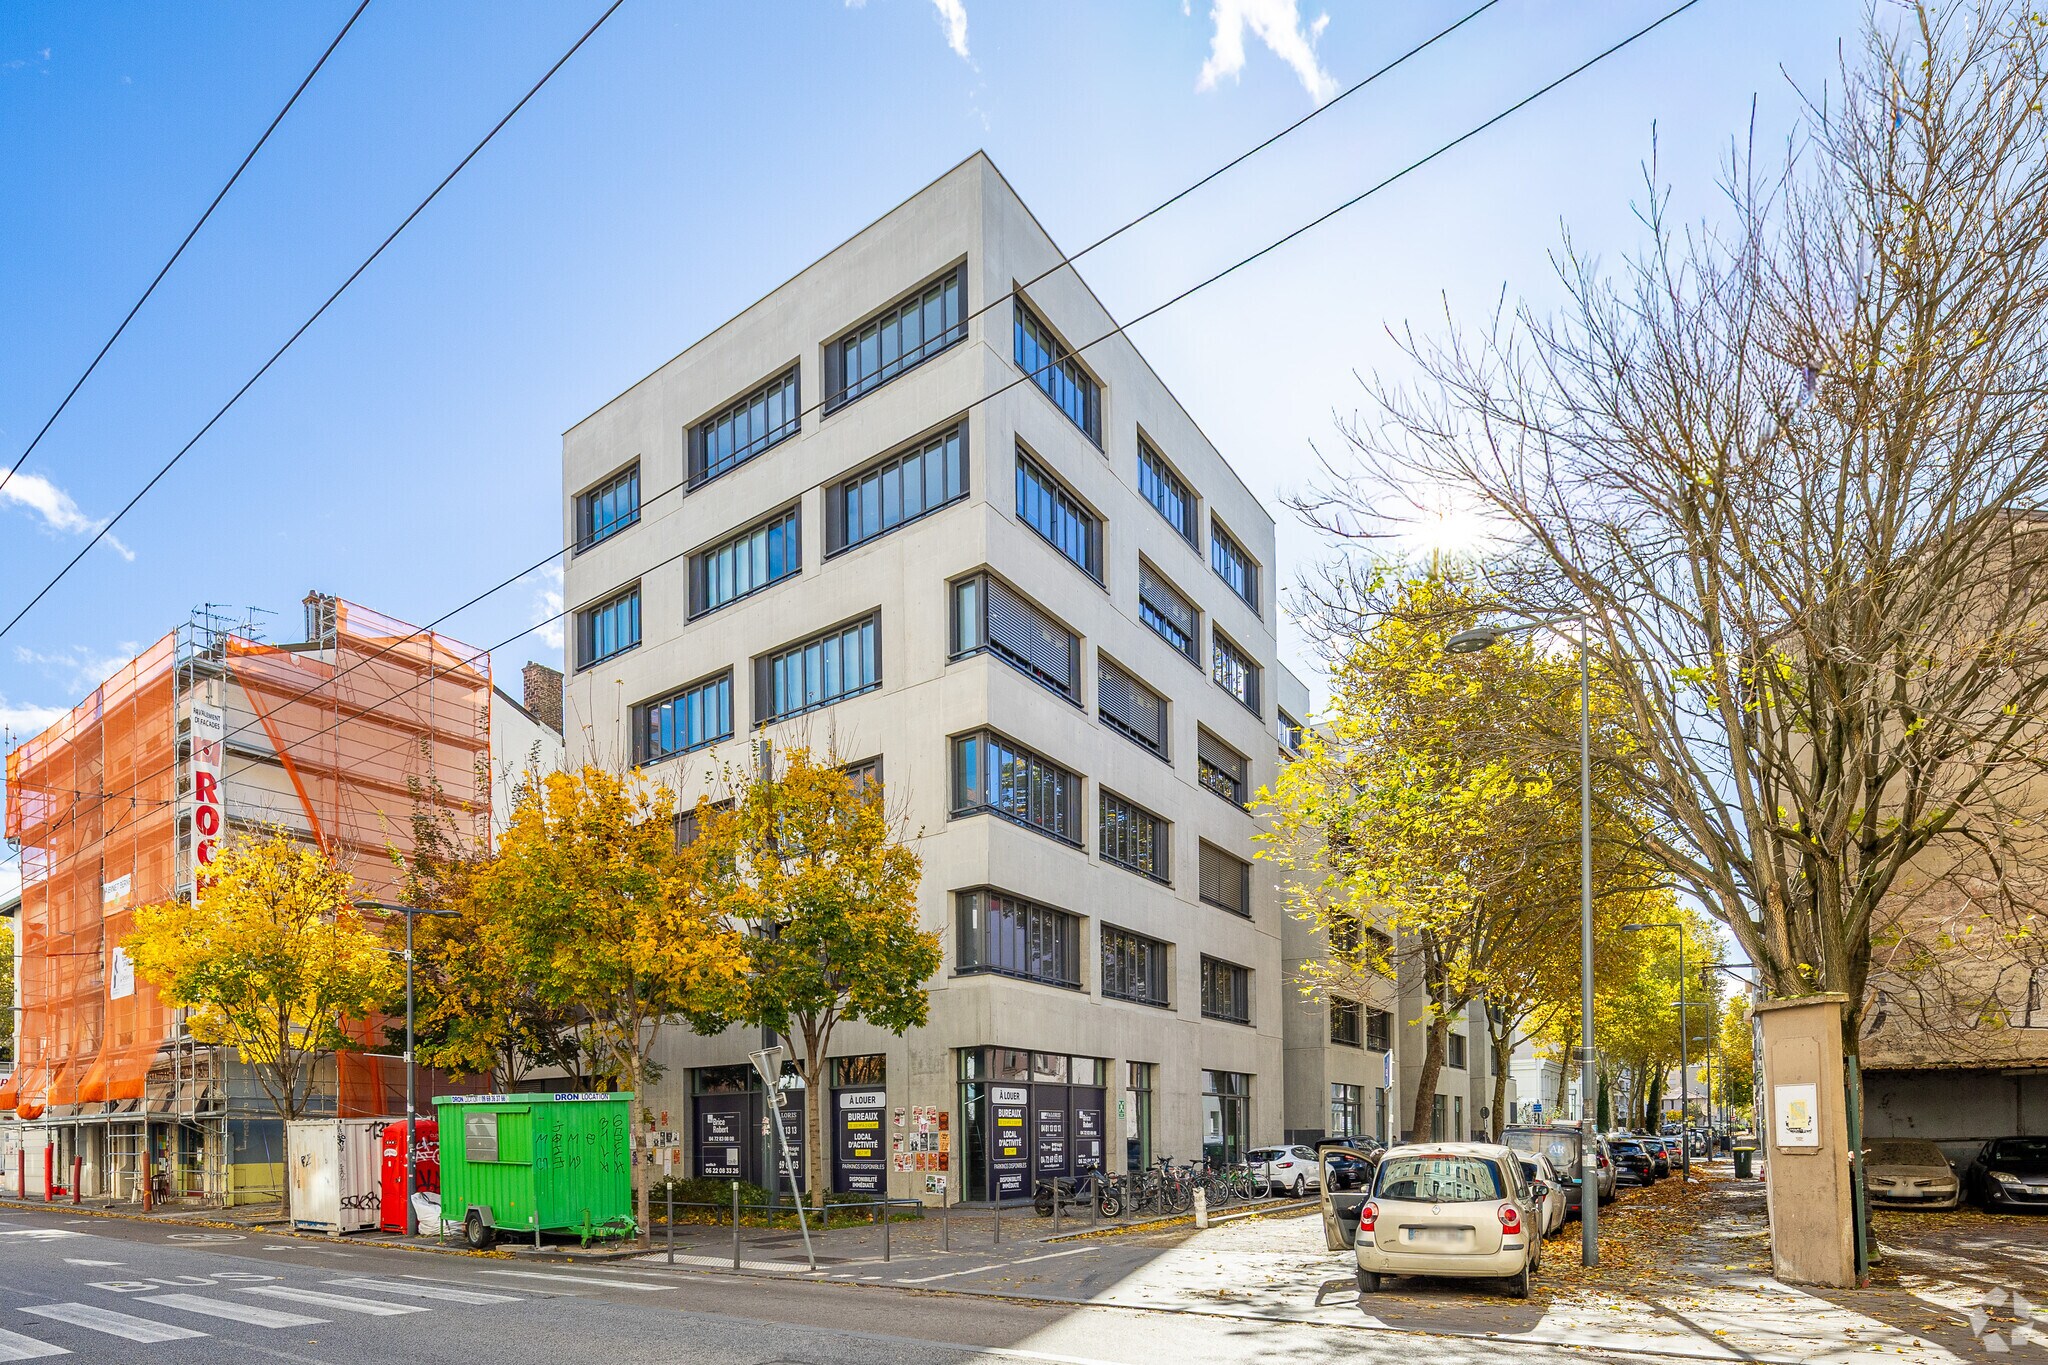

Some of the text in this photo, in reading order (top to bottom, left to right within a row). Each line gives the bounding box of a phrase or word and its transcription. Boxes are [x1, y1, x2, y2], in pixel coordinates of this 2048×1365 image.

[1000, 1090, 1020, 1100] À LOUER
[850, 1096, 876, 1104] À LOUER
[848, 1112, 878, 1121] BUREAUX
[998, 1108, 1022, 1118] BUREAUX
[786, 1126, 797, 1134] 13 13
[848, 1140, 878, 1148] D'ACTIVITÉ
[999, 1138, 1022, 1146] D'ACTIVITÉ
[84, 1272, 276, 1292] BUS
